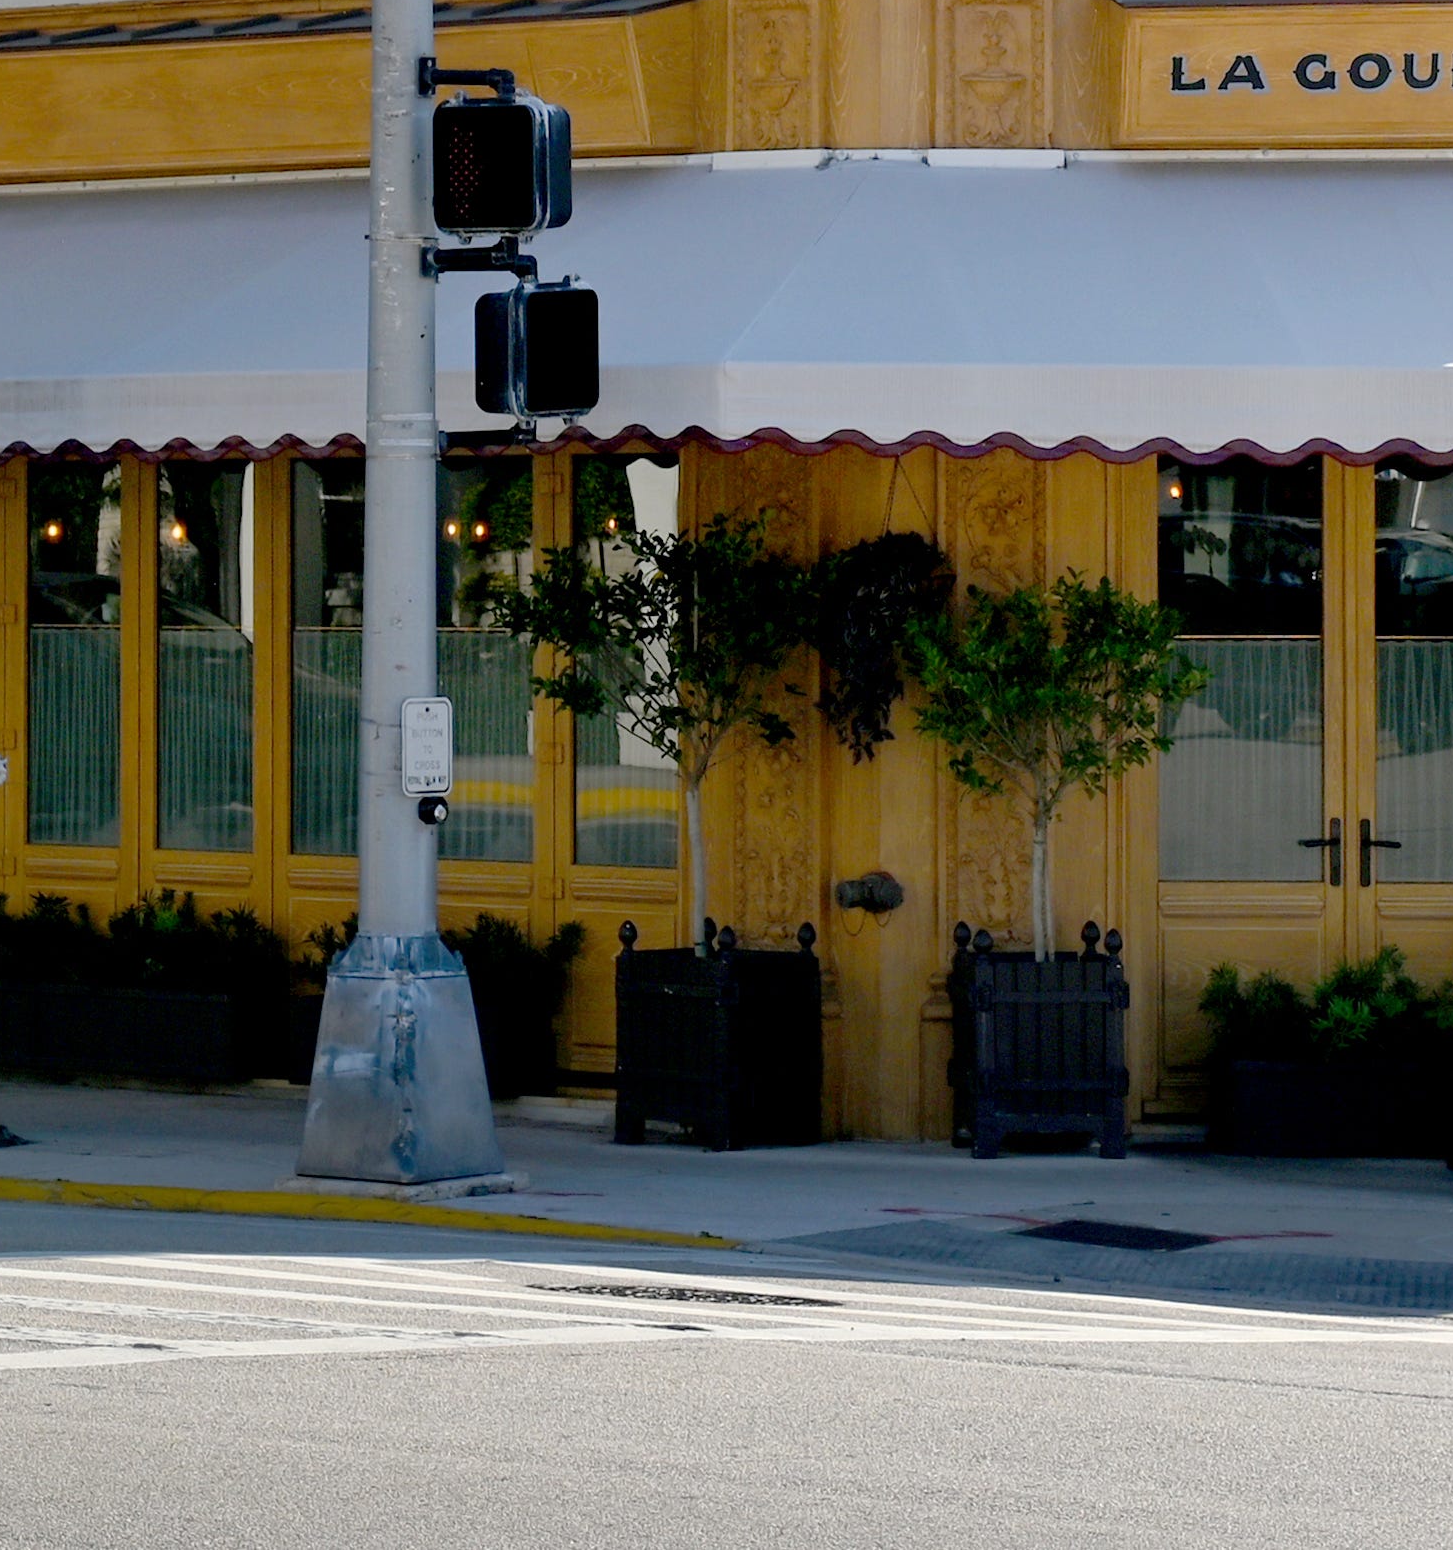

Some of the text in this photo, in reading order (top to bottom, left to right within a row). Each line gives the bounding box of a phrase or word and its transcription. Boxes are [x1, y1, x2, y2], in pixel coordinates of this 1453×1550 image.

[1170, 55, 1265, 91] LA
[411, 728, 444, 739] BUTTON
[422, 745, 434, 754] TO
[414, 760, 441, 770] CROSS
